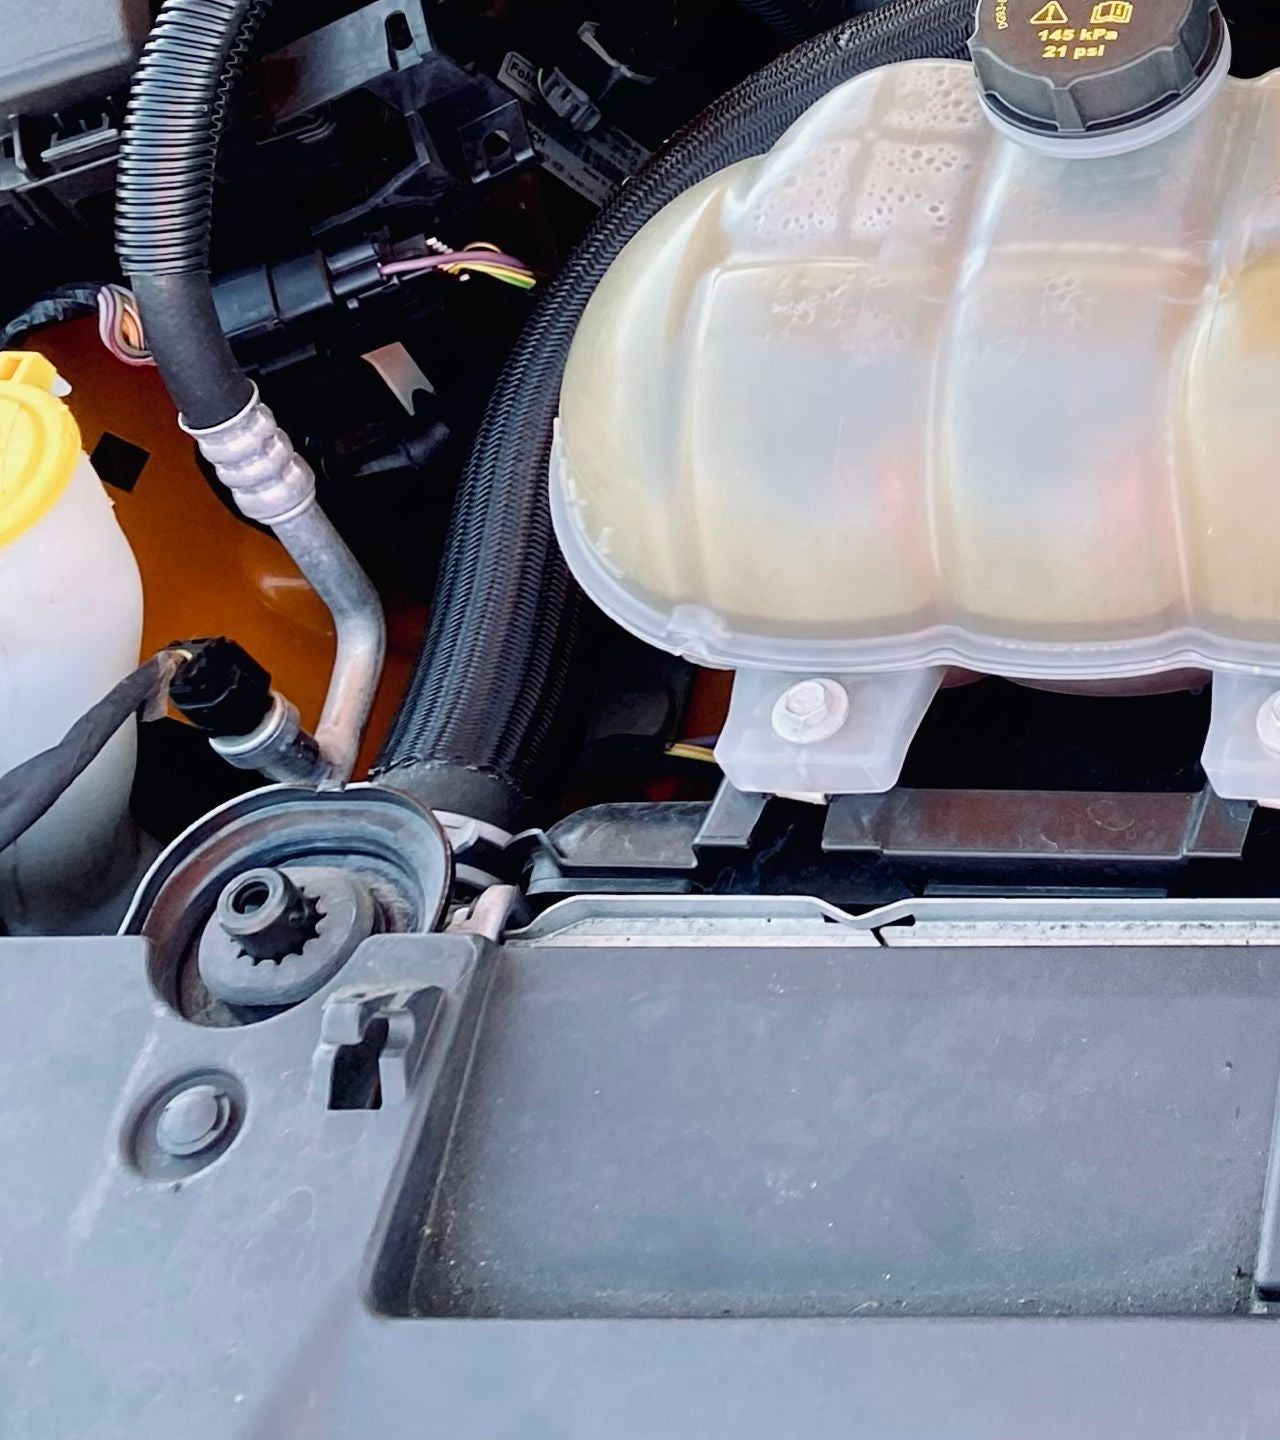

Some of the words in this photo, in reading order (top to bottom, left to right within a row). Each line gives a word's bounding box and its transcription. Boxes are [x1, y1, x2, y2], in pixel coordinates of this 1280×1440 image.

[1038, 28, 1075, 41] 145
[1079, 28, 1118, 41] kPa
[1042, 44, 1067, 58] 21
[1073, 44, 1105, 60] psi
